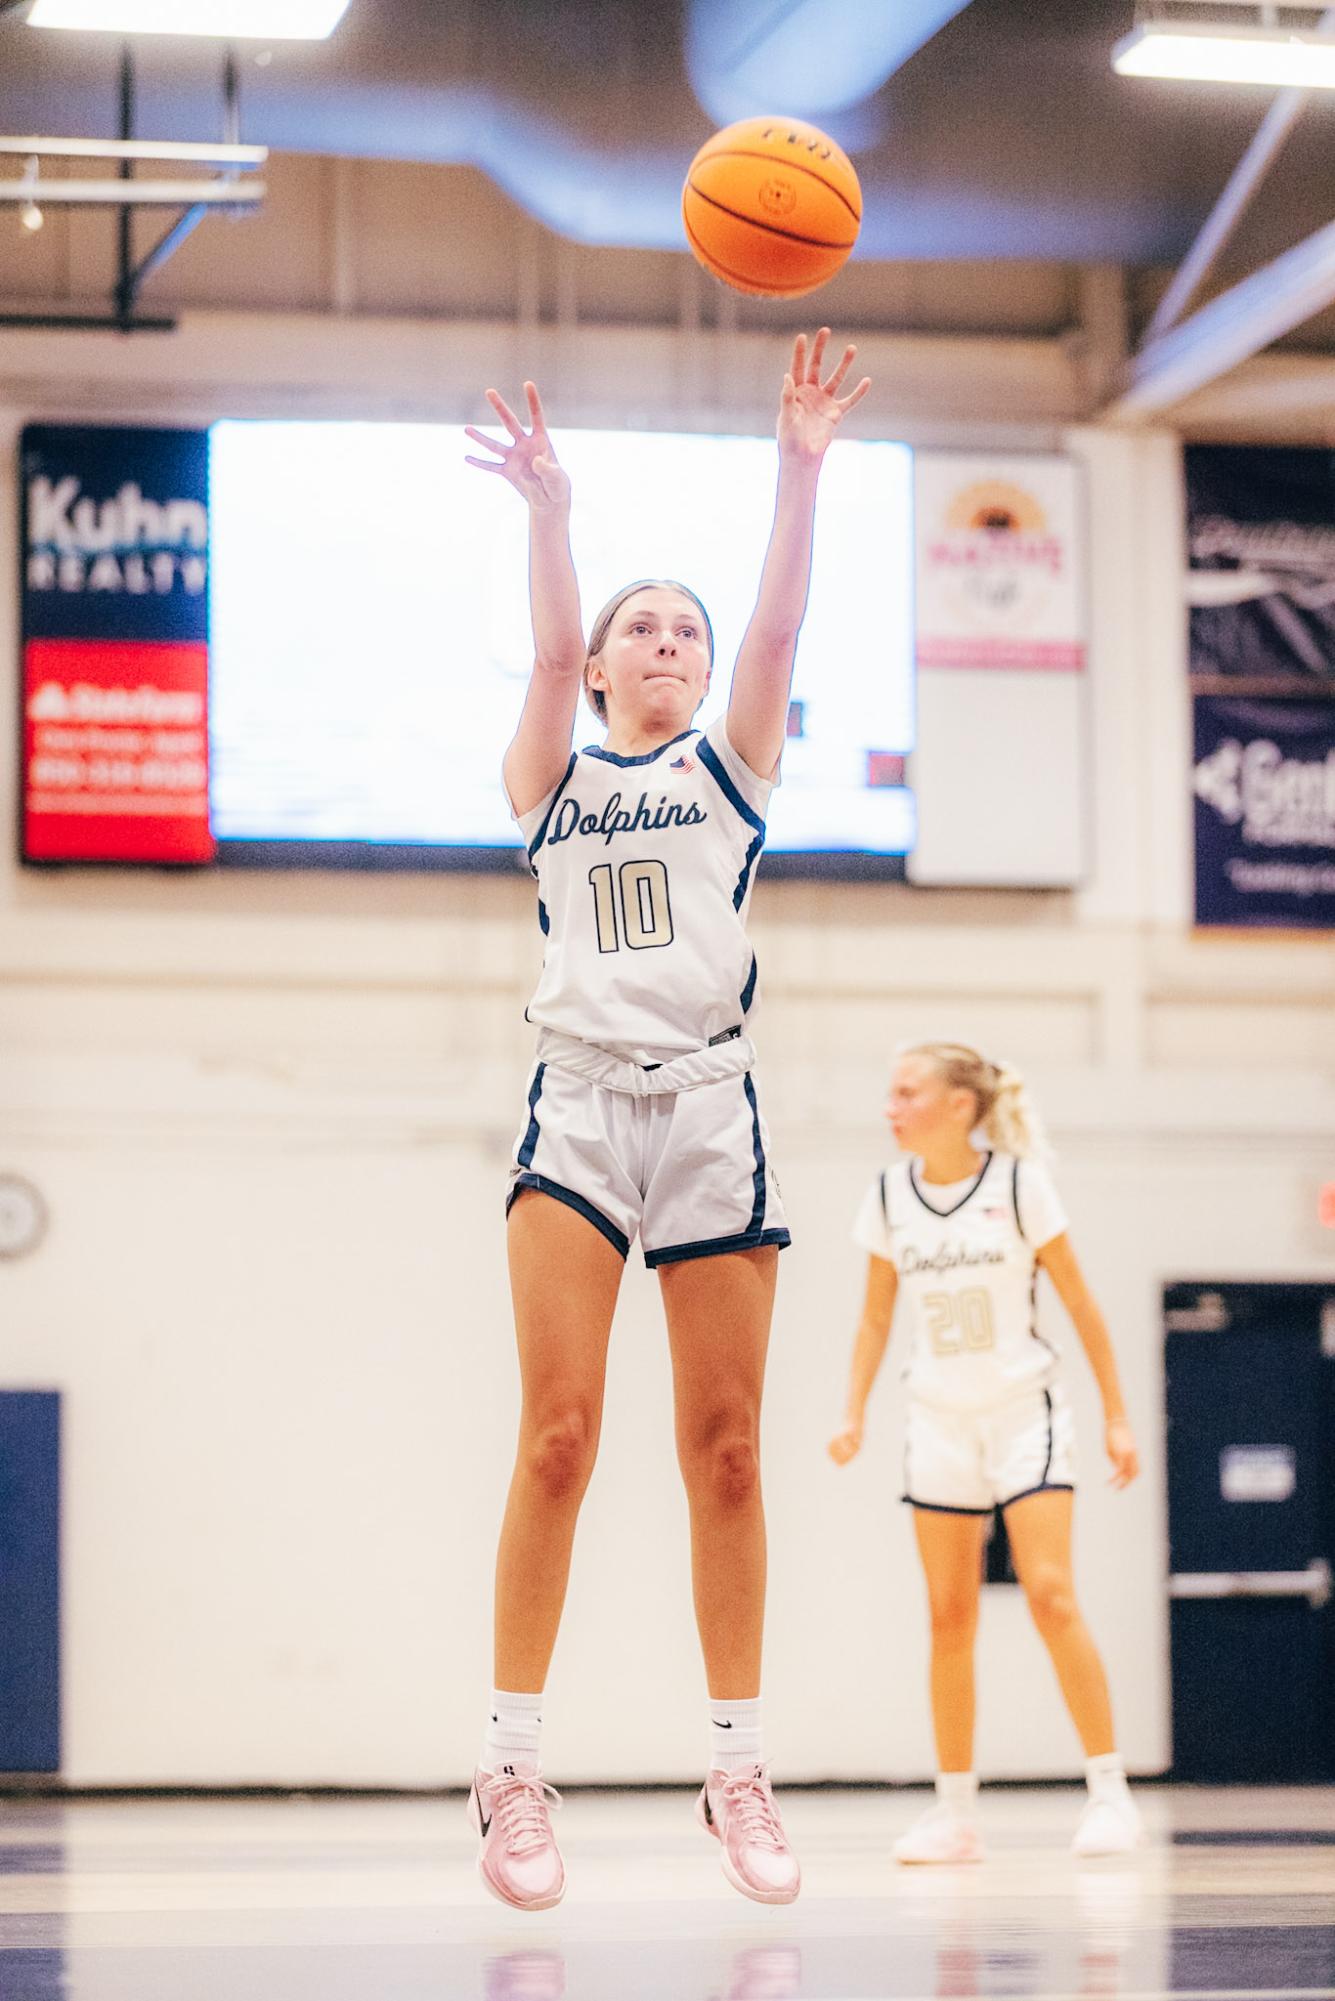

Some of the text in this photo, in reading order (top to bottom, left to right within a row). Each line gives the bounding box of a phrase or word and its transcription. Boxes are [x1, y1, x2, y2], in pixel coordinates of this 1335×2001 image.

[29, 475, 207, 553] Kuhn
[27, 553, 206, 594] REALTY
[547, 791, 707, 846] Dolphins
[588, 859, 674, 954] 10
[924, 1288, 994, 1356] 20
